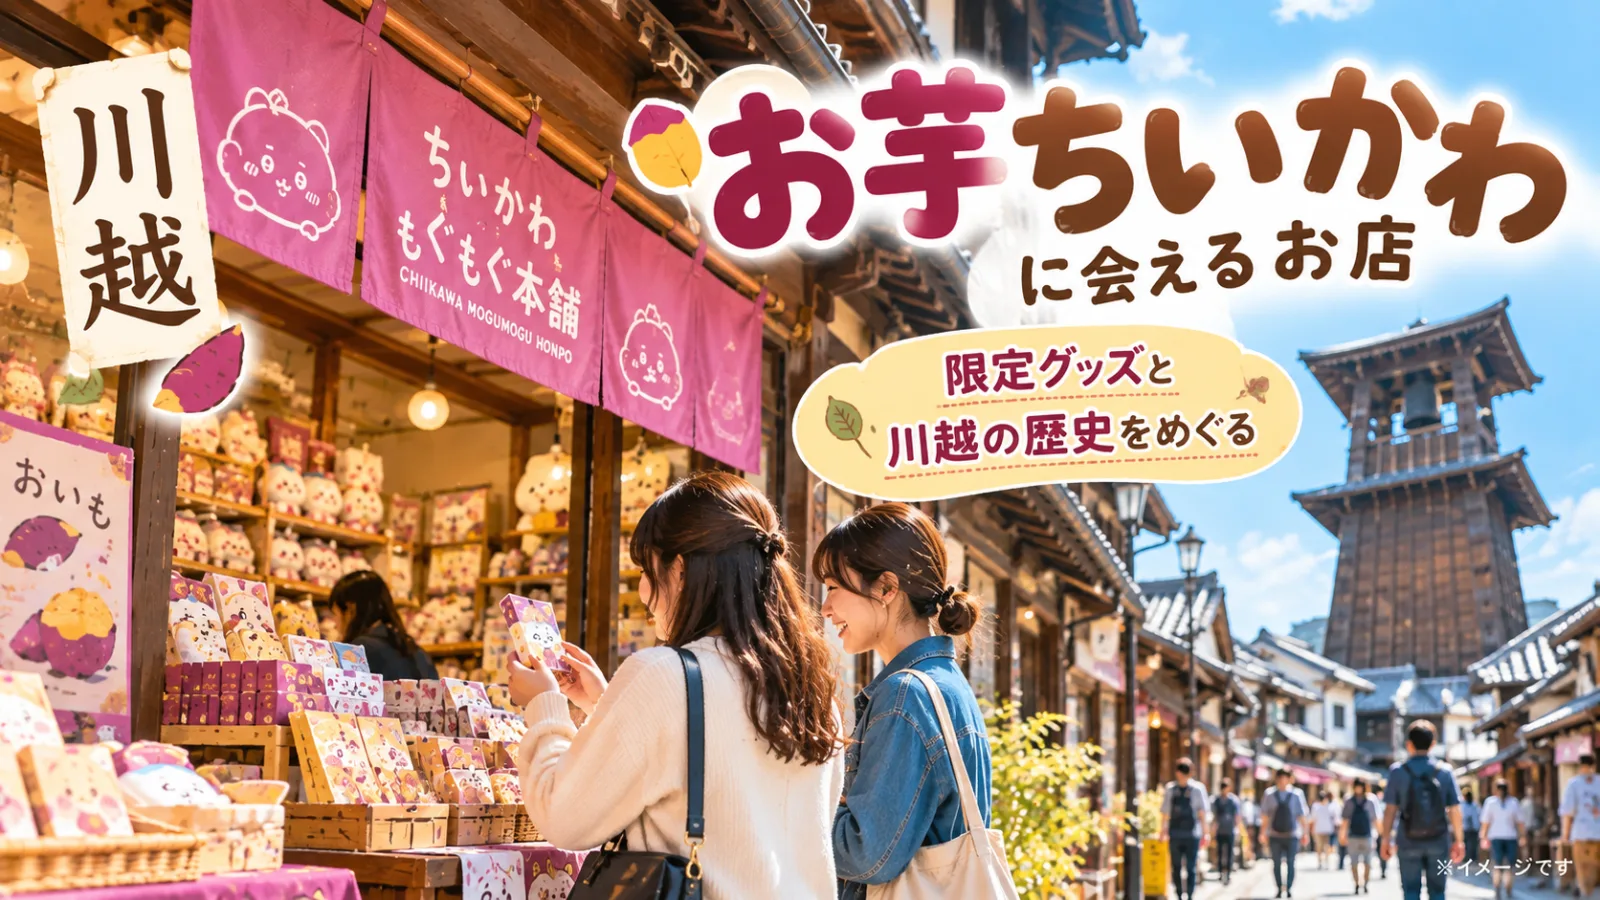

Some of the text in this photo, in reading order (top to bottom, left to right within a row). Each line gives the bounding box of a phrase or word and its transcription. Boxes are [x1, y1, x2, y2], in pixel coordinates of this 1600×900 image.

[423, 125, 556, 250] ちいかわ
[397, 210, 581, 339] もぐもぐ本舗
[399, 265, 573, 364] CHIIKAWA MOGUMOGU HONPO
[13, 457, 111, 530] おいも
